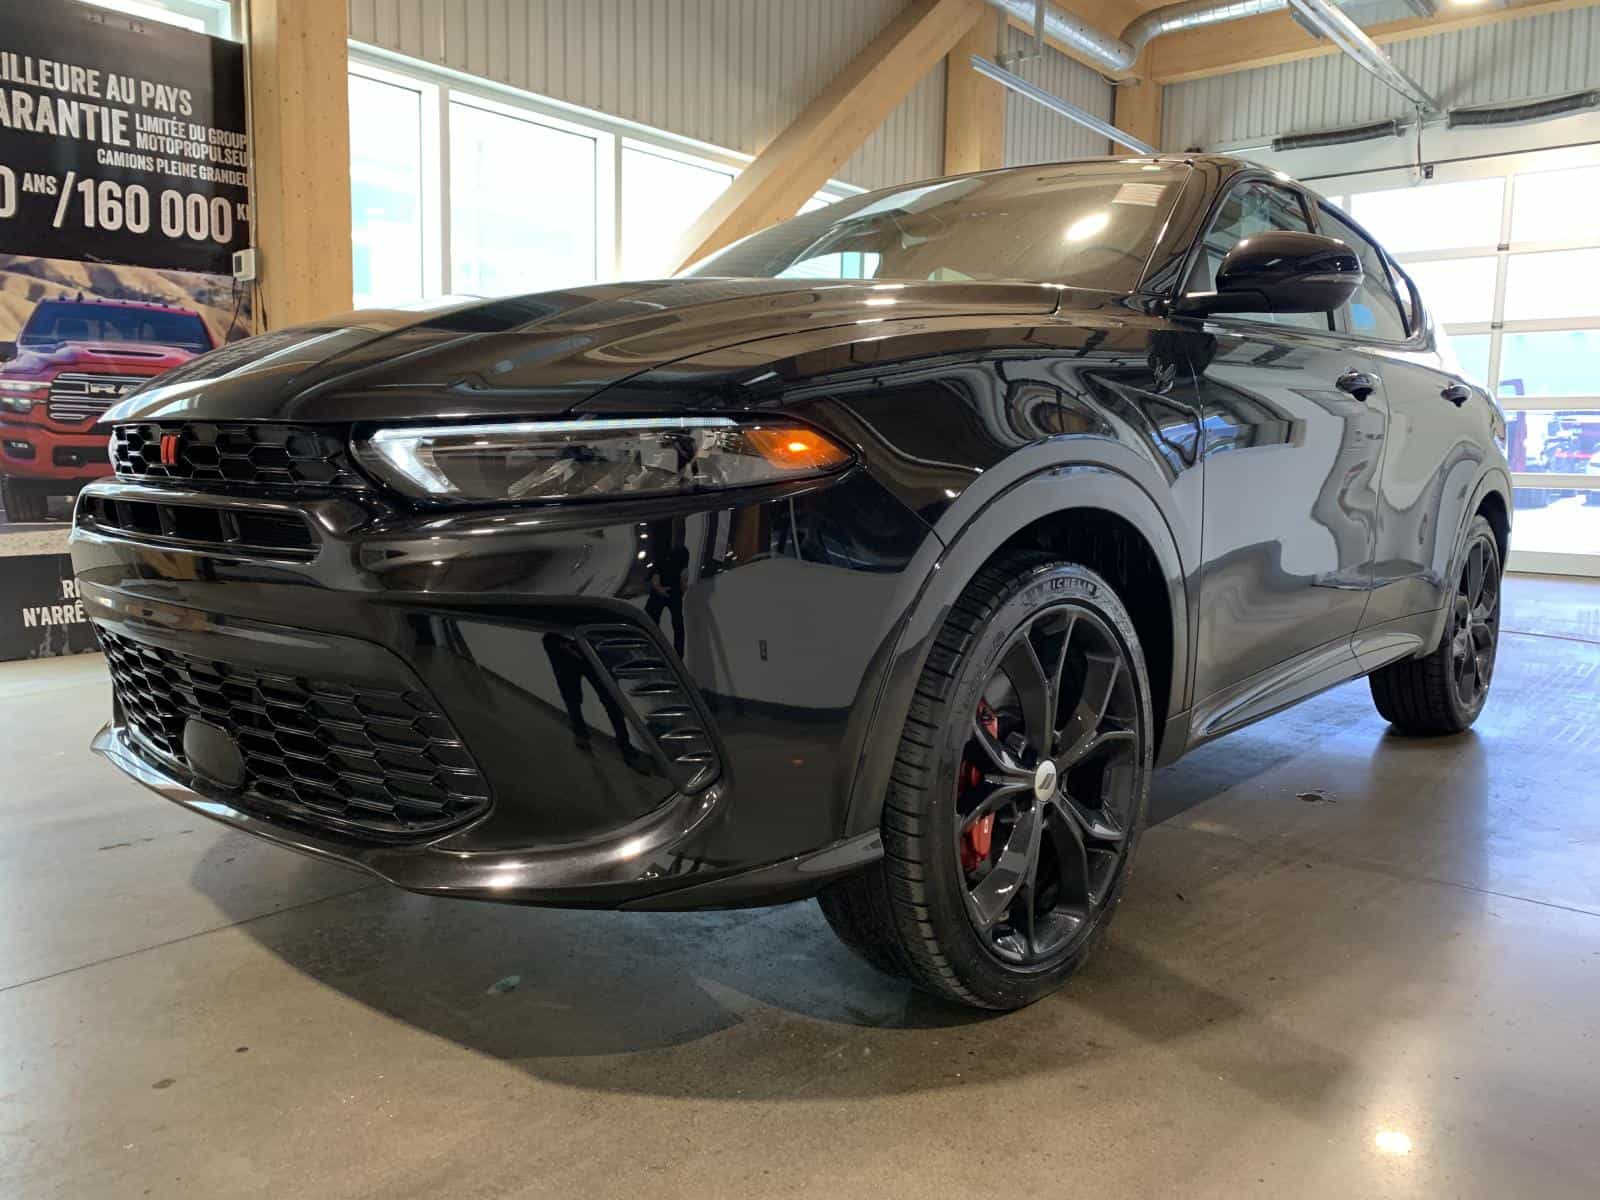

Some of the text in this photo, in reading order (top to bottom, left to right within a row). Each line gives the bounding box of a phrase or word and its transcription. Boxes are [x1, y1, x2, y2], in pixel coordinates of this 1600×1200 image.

[0, 51, 192, 116] ILLEURE AU PAYS
[135, 112, 187, 139] LIMITÉE
[189, 123, 206, 142] DU
[97, 148, 154, 172] CAMIONS
[156, 158, 198, 179] PLEINE
[22, 173, 57, 195] ANS
[160, 189, 233, 244] 000
[236, 203, 249, 221] K
[22, 599, 87, 627] N'ARRÊ
